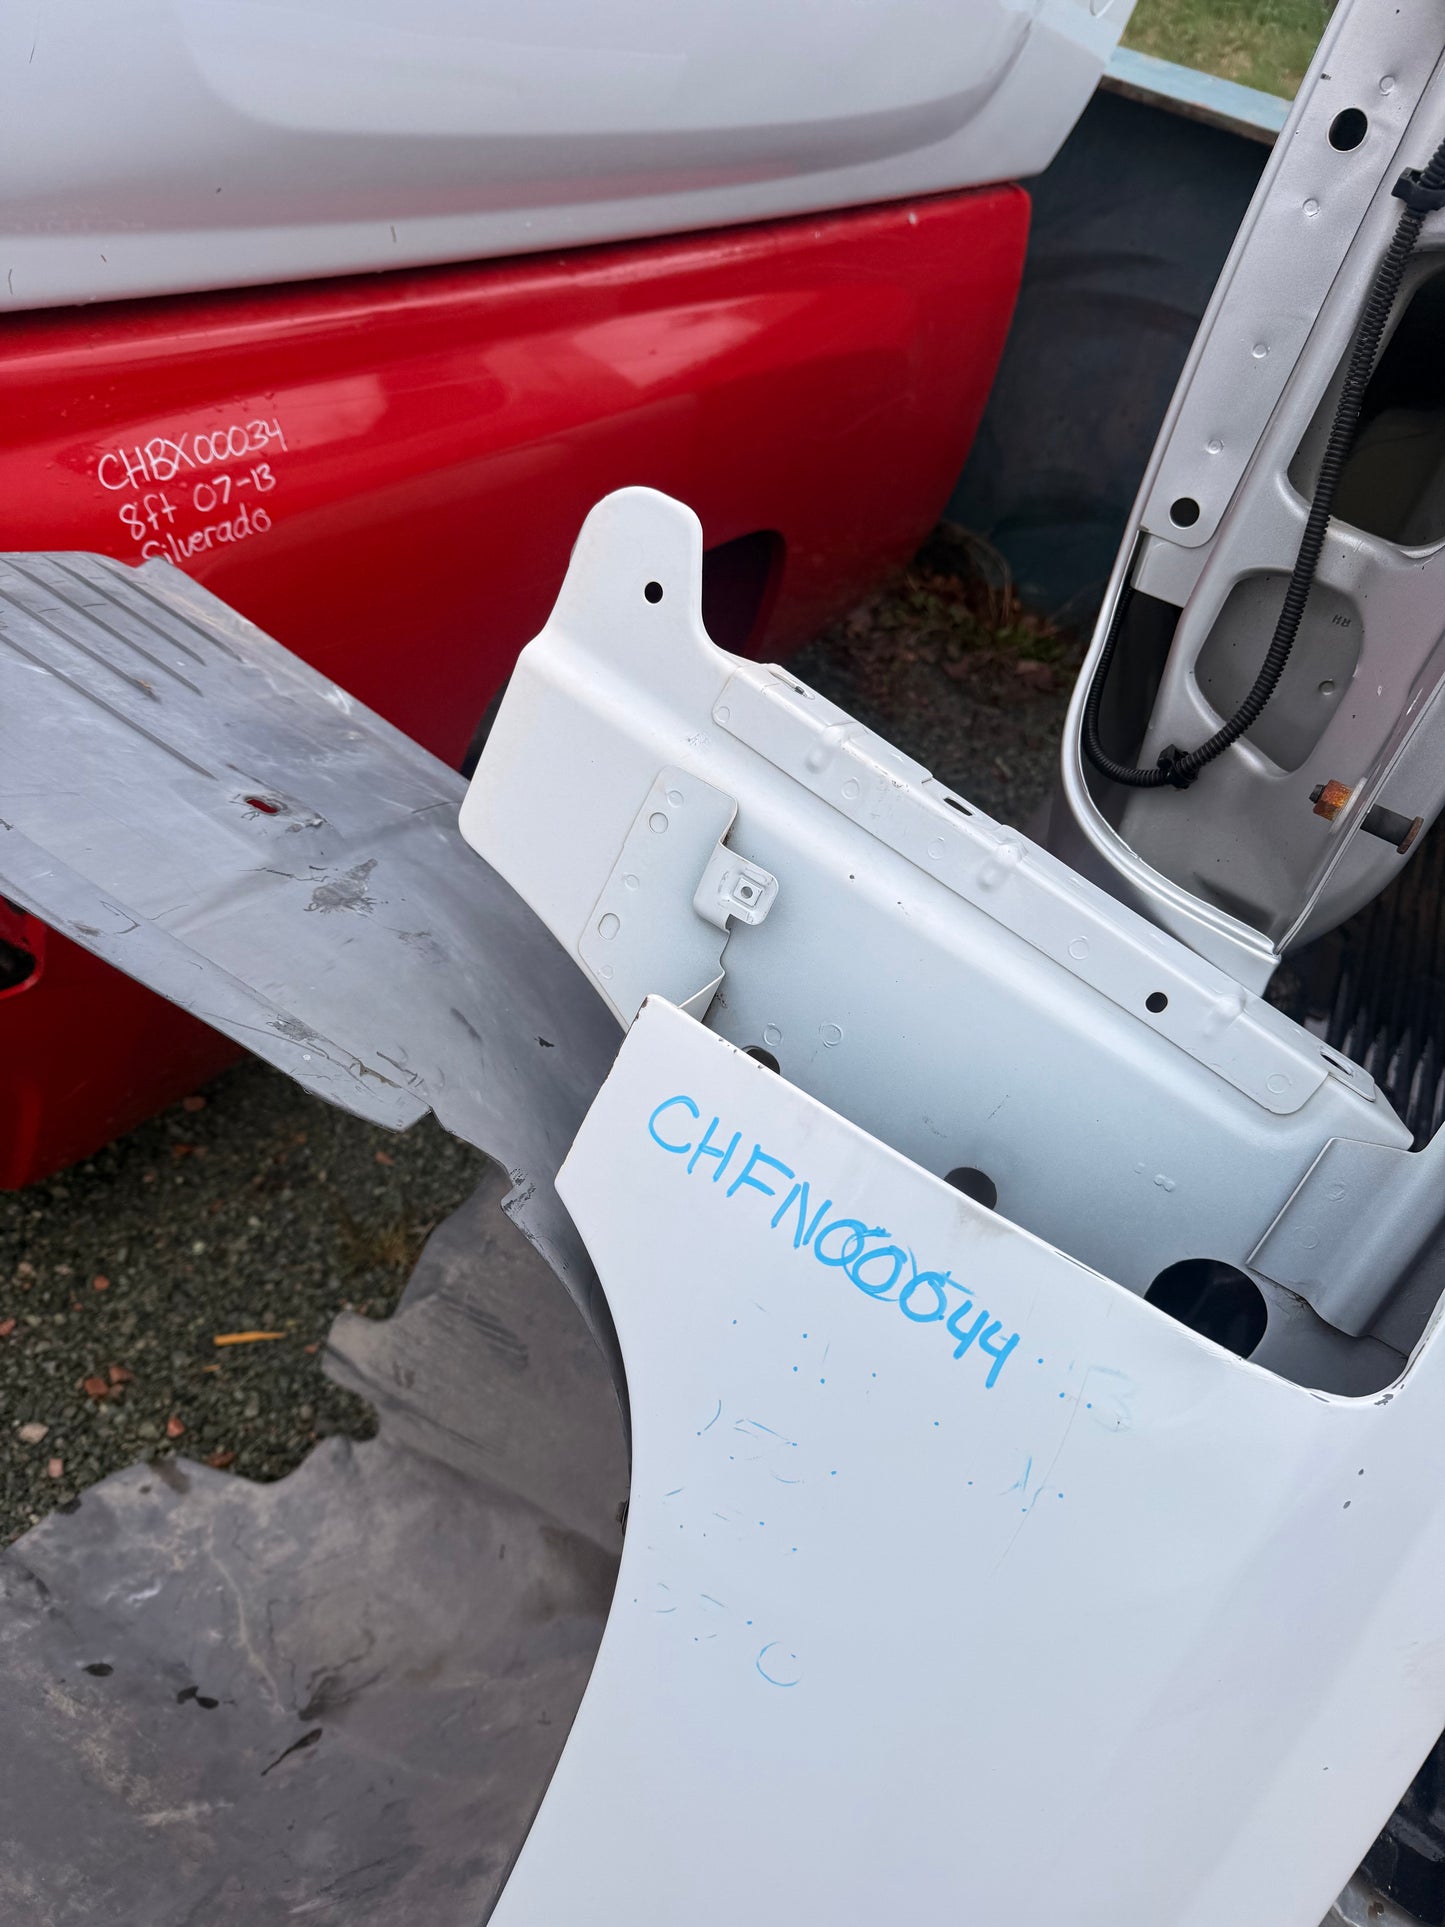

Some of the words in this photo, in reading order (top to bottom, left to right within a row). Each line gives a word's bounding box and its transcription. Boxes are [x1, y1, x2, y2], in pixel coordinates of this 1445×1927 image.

[98, 418, 288, 490] CHBX00034
[119, 492, 177, 540] 8ft
[193, 463, 276, 511] 07-13
[648, 1095, 1021, 1388] CHFN00044
